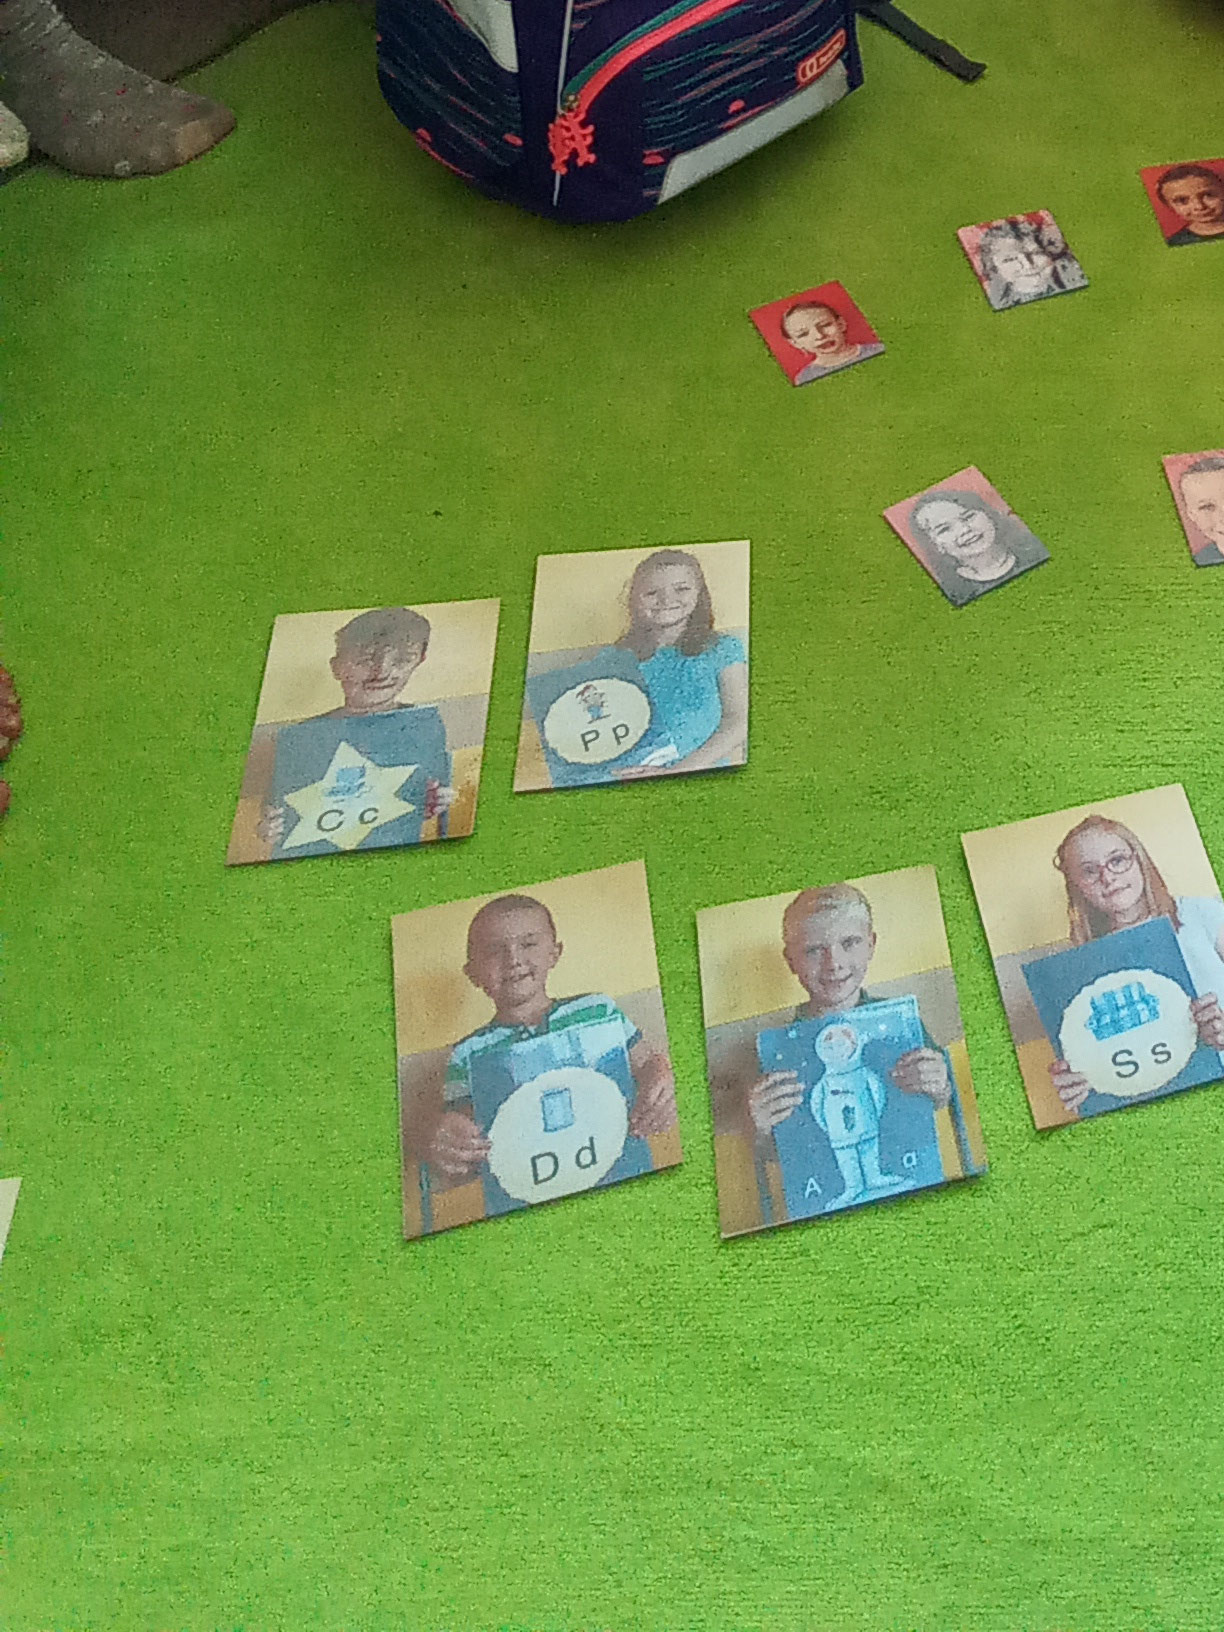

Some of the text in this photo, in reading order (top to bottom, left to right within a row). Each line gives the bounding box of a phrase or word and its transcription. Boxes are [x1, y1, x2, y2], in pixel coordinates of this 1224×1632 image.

[580, 729, 600, 752] P
[316, 809, 345, 832] C
[1111, 1049, 1140, 1078] S
[530, 1136, 598, 1185] D d
[804, 1177, 823, 1199] A
